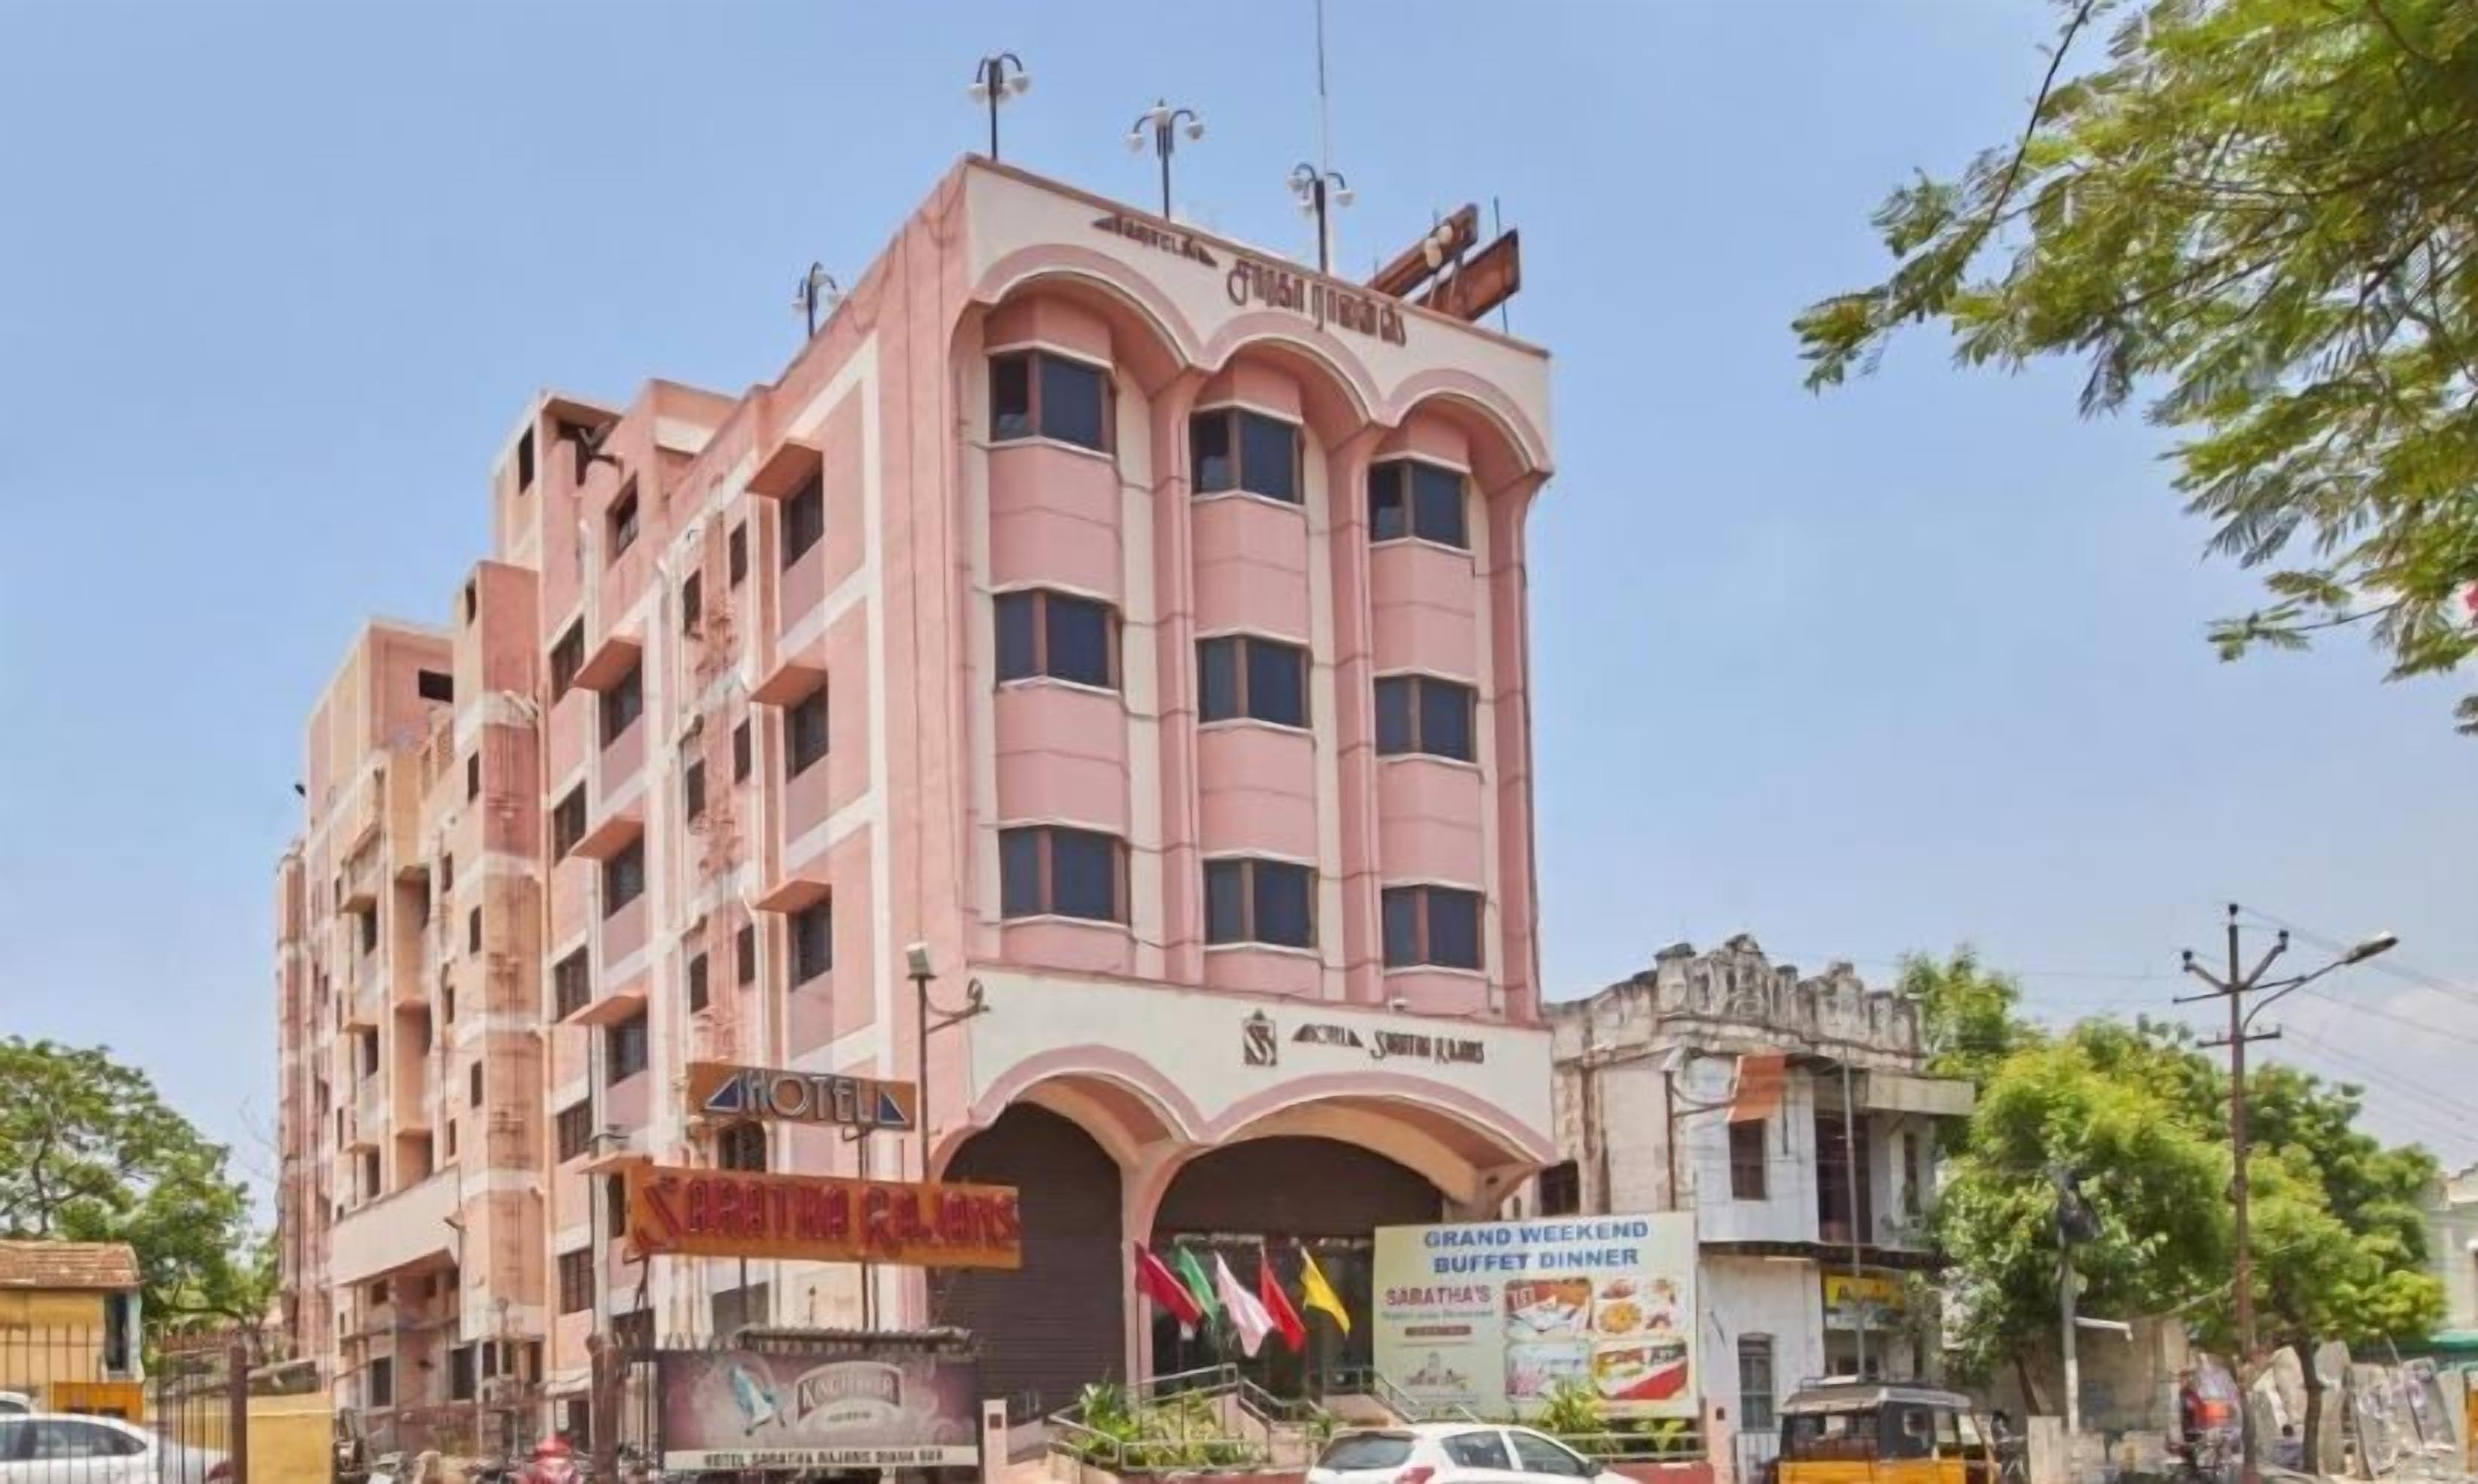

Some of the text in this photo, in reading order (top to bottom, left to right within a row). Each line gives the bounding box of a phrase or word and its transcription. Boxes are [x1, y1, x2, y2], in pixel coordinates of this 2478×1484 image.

[746, 1069, 872, 1123] HOTEL
[1424, 1221, 1649, 1248] GRAND WEEKEND
[1433, 1248, 1639, 1274] BUFFET DINNER
